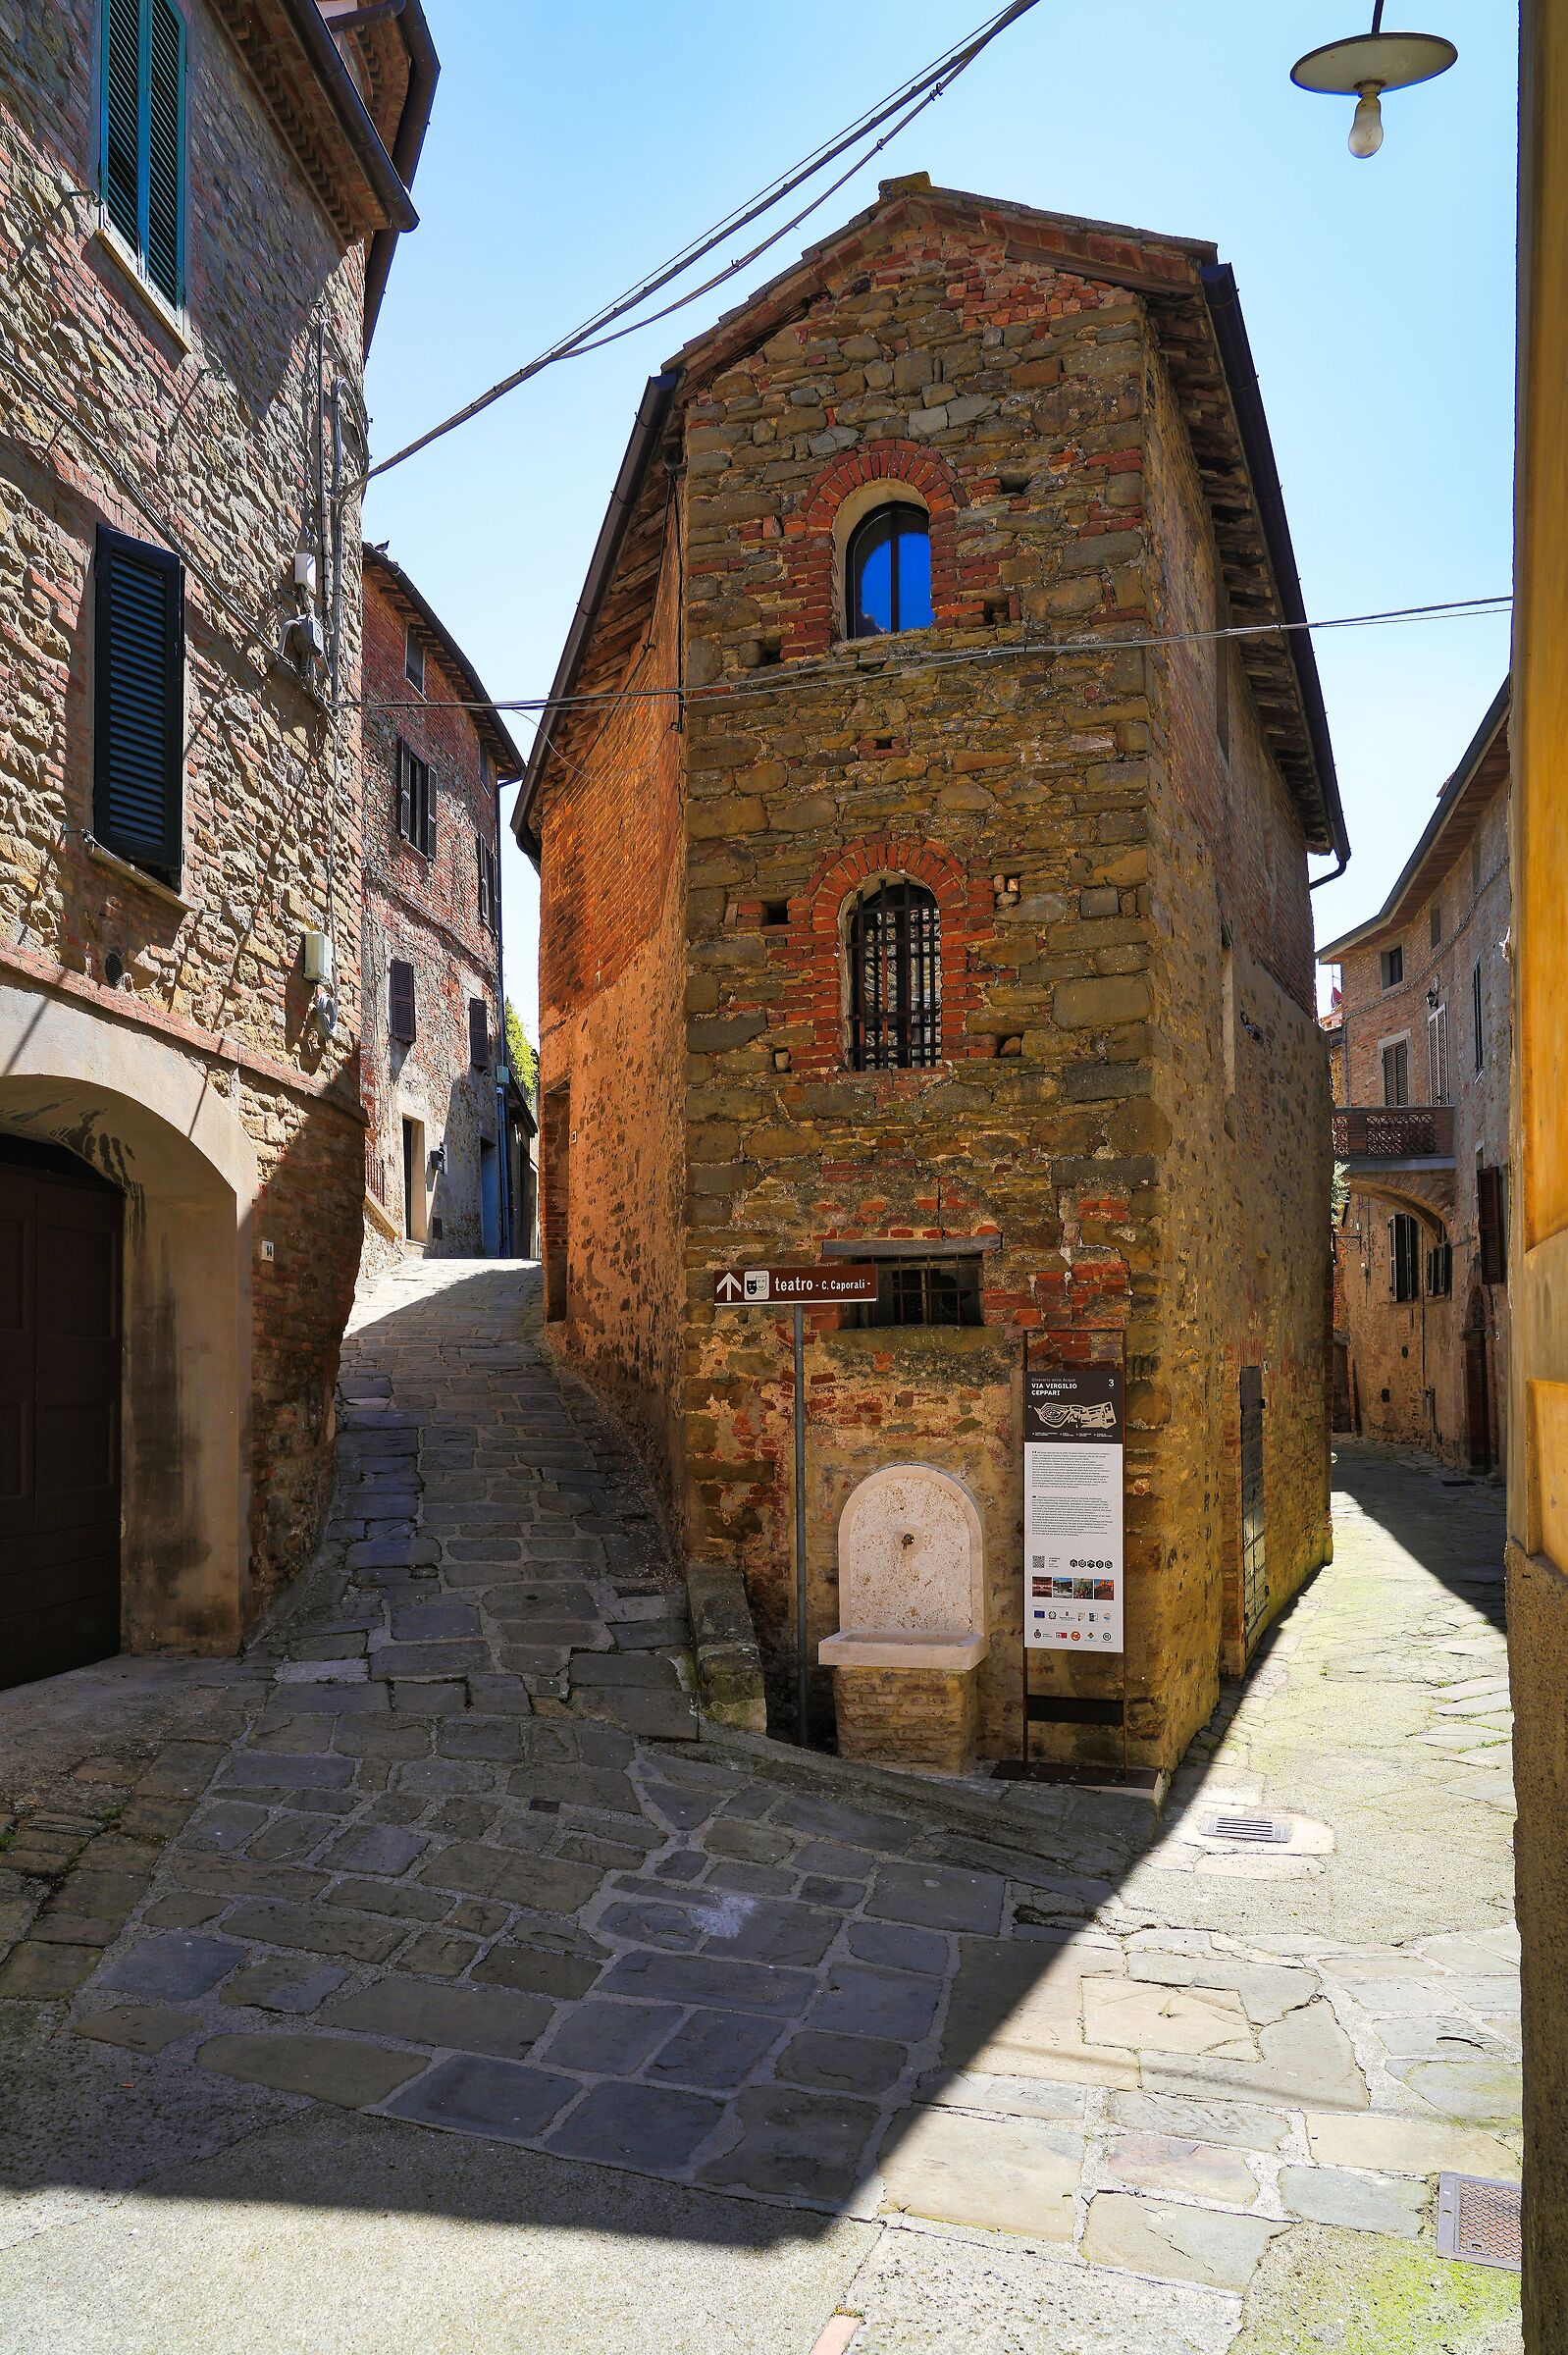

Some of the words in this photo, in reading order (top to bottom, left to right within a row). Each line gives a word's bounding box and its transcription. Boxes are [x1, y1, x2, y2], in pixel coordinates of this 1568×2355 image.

[774, 1276, 813, 1292] teatro
[821, 1280, 829, 1290] C.
[831, 1279, 865, 1292] Caporali
[1108, 1378, 1115, 1387] 3
